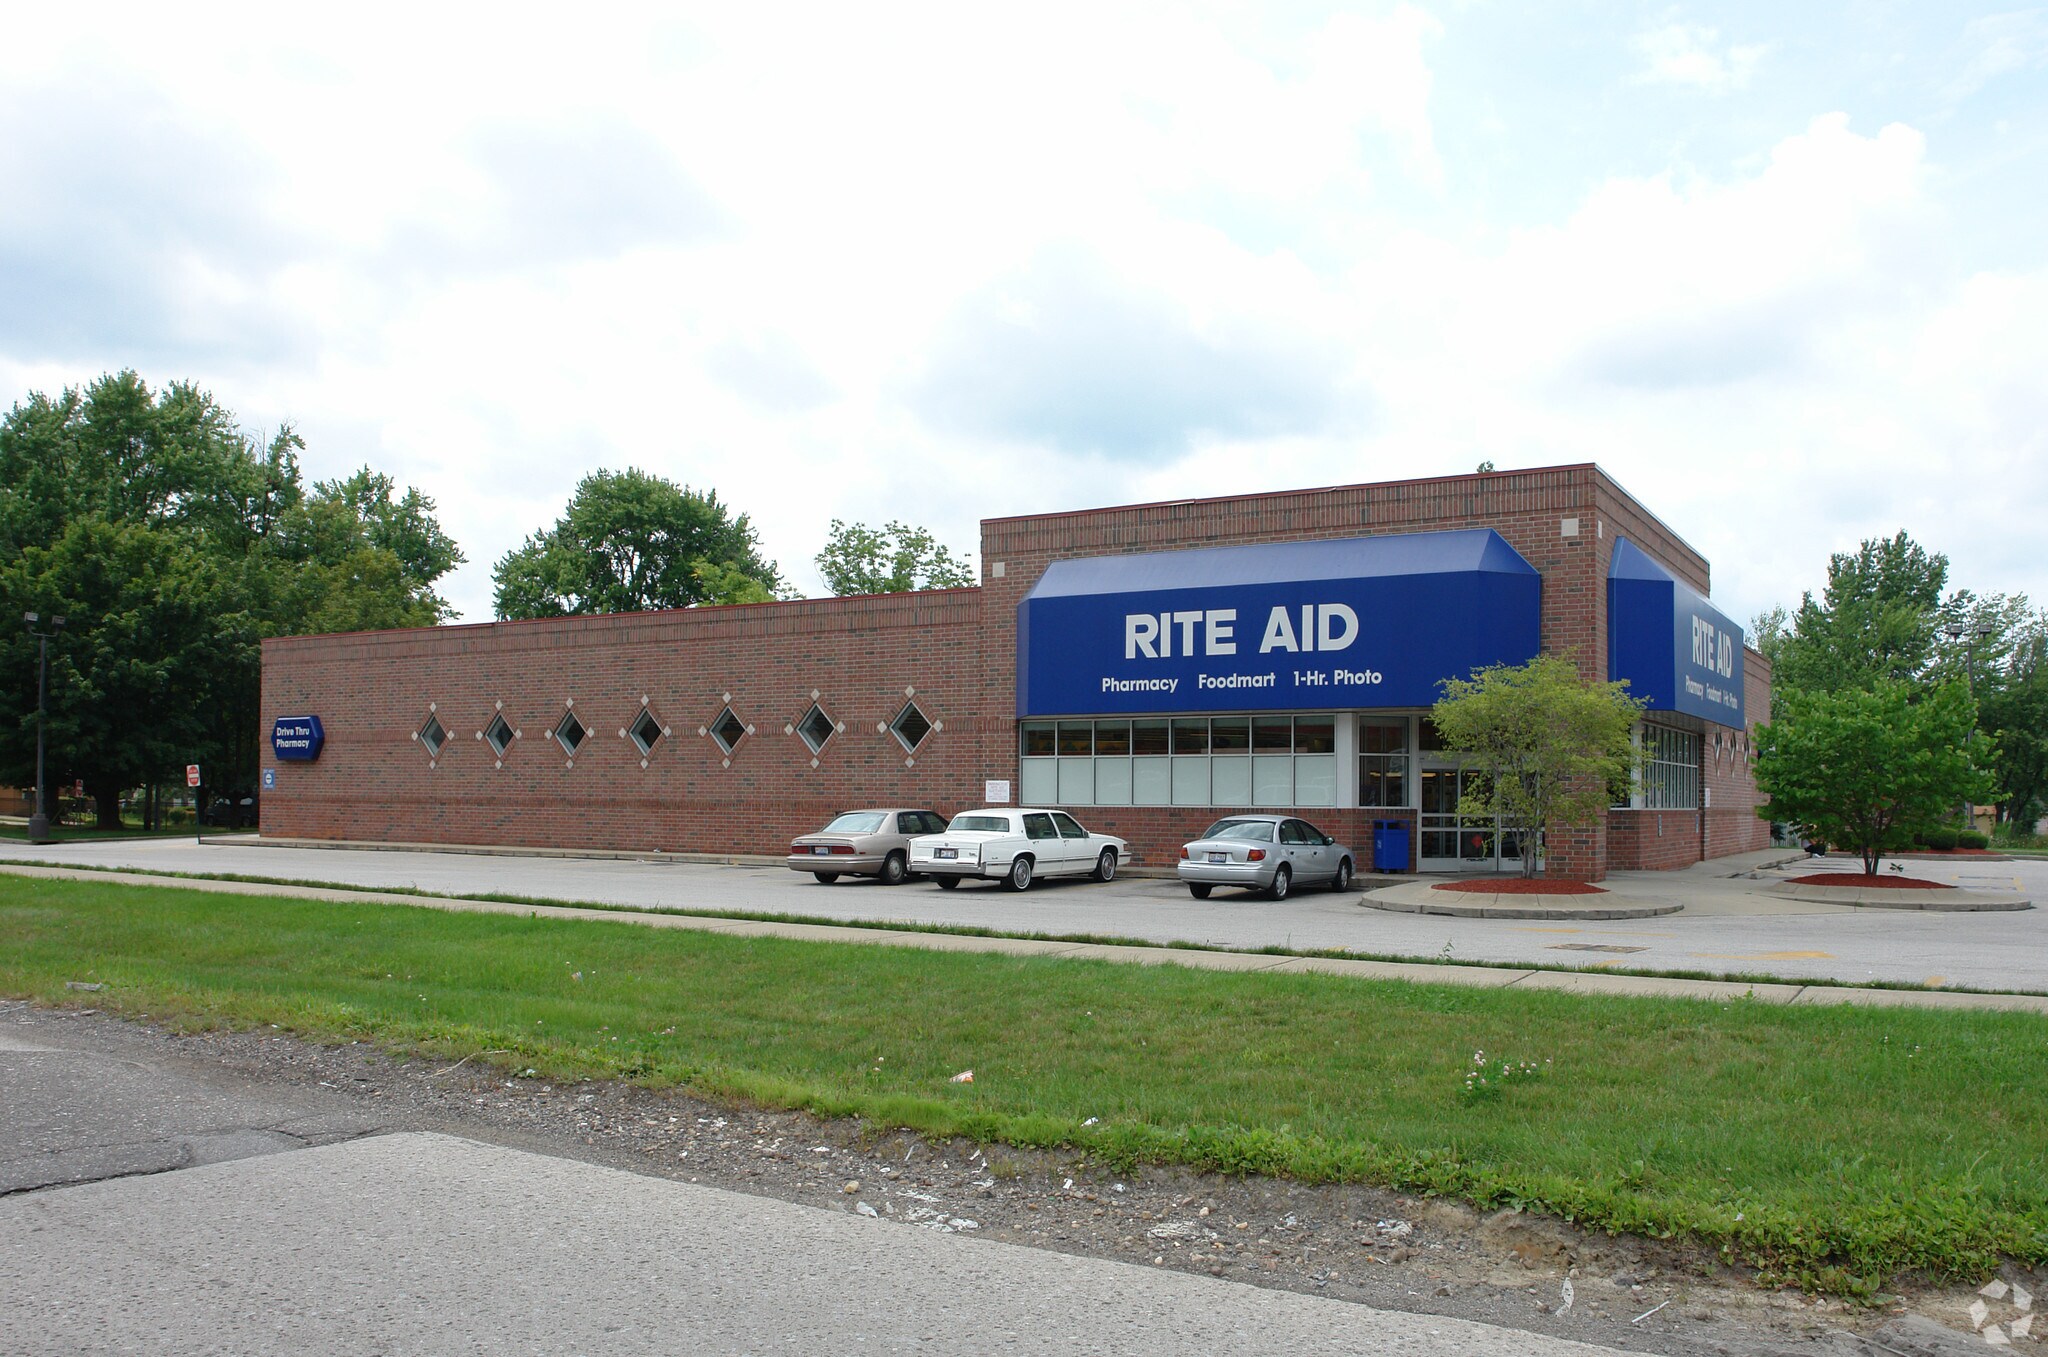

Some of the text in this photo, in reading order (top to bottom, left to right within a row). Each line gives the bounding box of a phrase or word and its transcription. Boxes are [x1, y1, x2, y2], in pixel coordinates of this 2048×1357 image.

[1125, 603, 1360, 660] RITE AID
[1692, 614, 1733, 679] RITE AID
[1102, 669, 1383, 694] Pharmacy Foodmart 1-Hr. Photo
[276, 726, 310, 736] Drive Thru
[276, 739, 310, 749] Pharmacy
